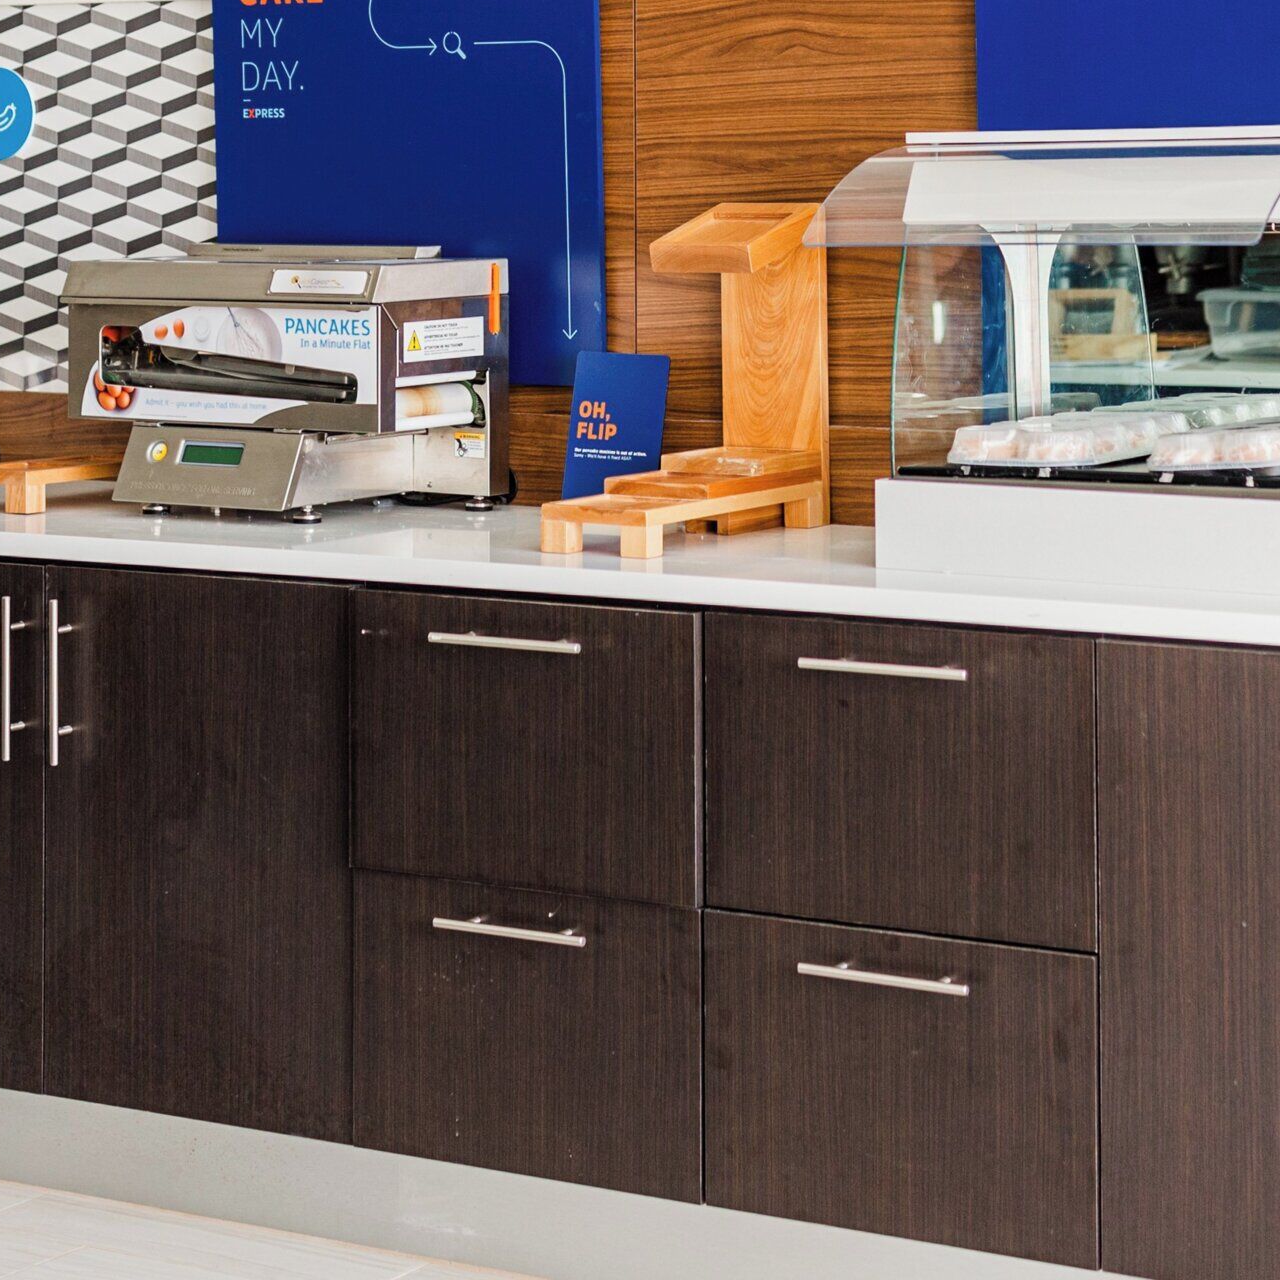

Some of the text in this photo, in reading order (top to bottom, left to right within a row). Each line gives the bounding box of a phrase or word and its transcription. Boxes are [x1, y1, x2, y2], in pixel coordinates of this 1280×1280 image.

[240, 18, 283, 49] MY
[241, 60, 304, 91] DAY.
[243, 108, 285, 119] EXPRESS
[285, 318, 371, 336] PANCAKES
[300, 338, 309, 348] In
[320, 339, 351, 349] Minute
[353, 339, 371, 350] Flat
[578, 400, 611, 422] OH,
[576, 421, 617, 440] FLIP
